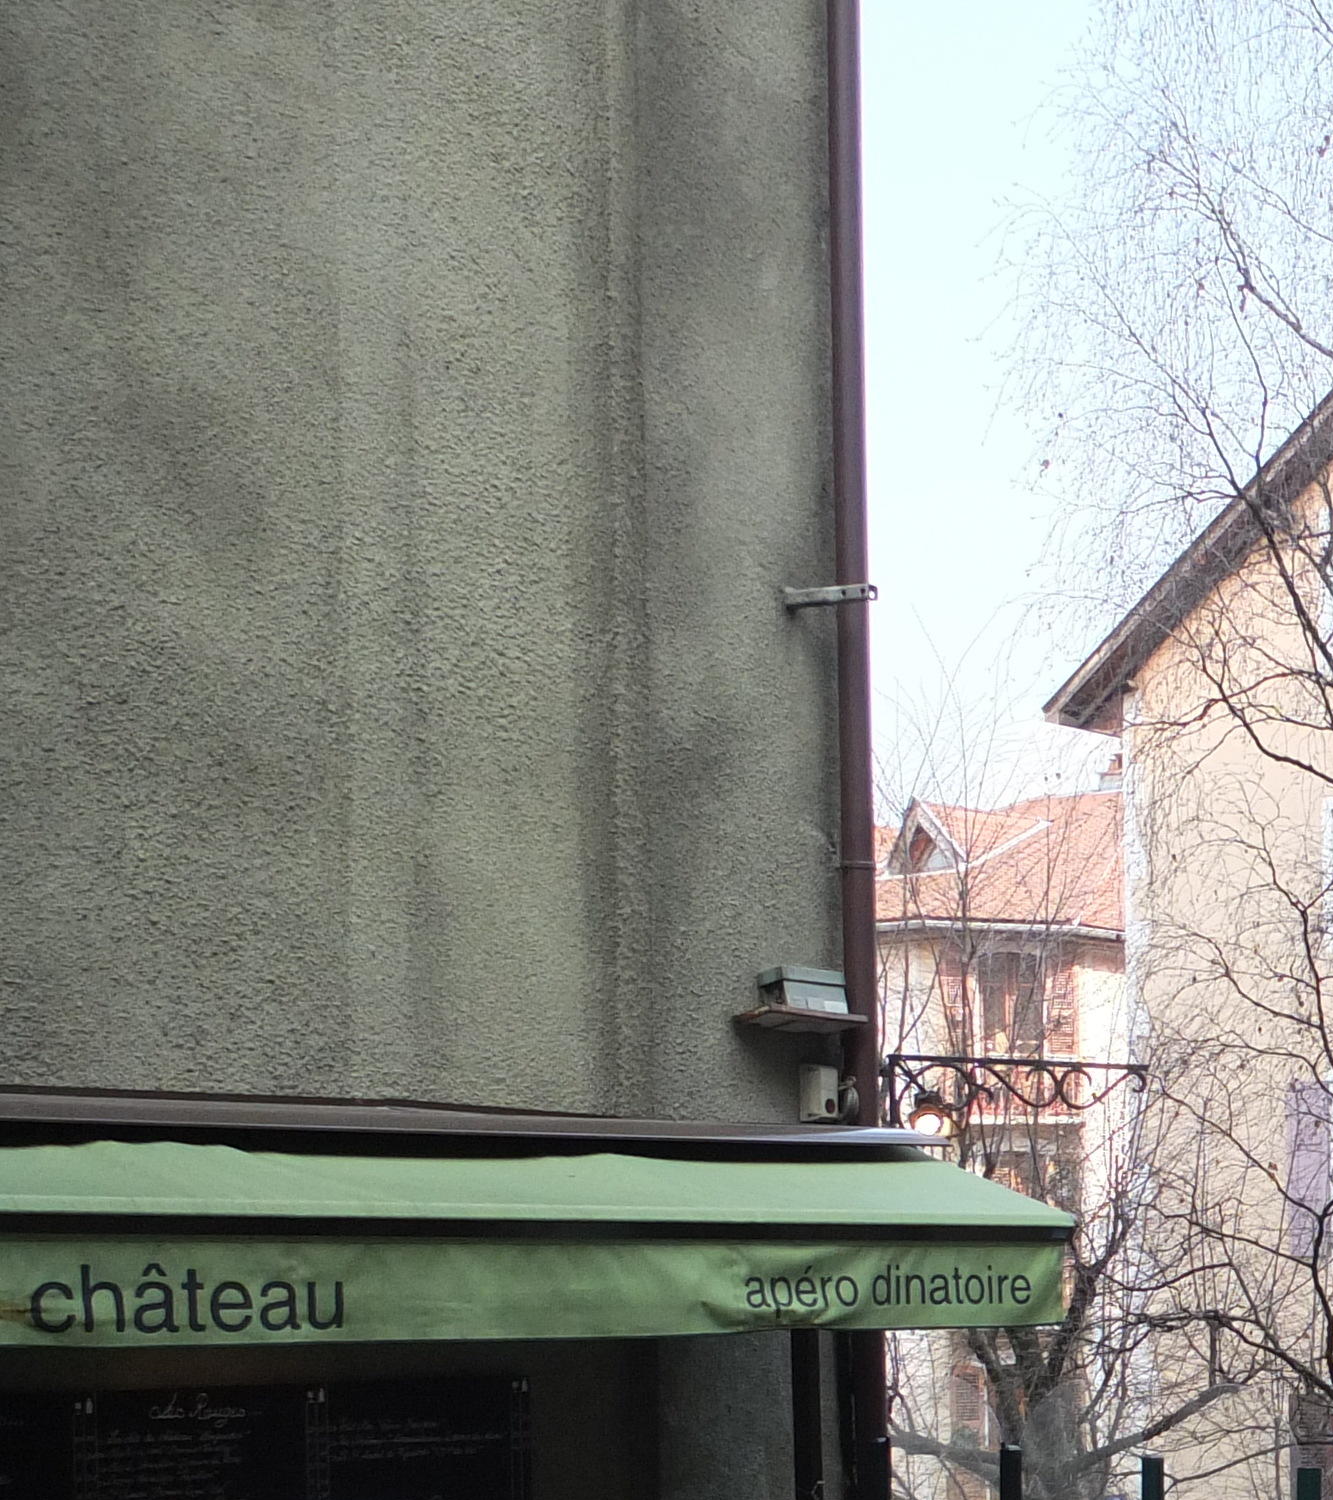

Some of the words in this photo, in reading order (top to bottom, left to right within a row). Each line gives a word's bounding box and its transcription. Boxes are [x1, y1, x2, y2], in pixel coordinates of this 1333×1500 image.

[31, 1262, 345, 1334] château
[744, 1265, 859, 1319] apéro
[871, 1264, 1032, 1305] dinatoire
